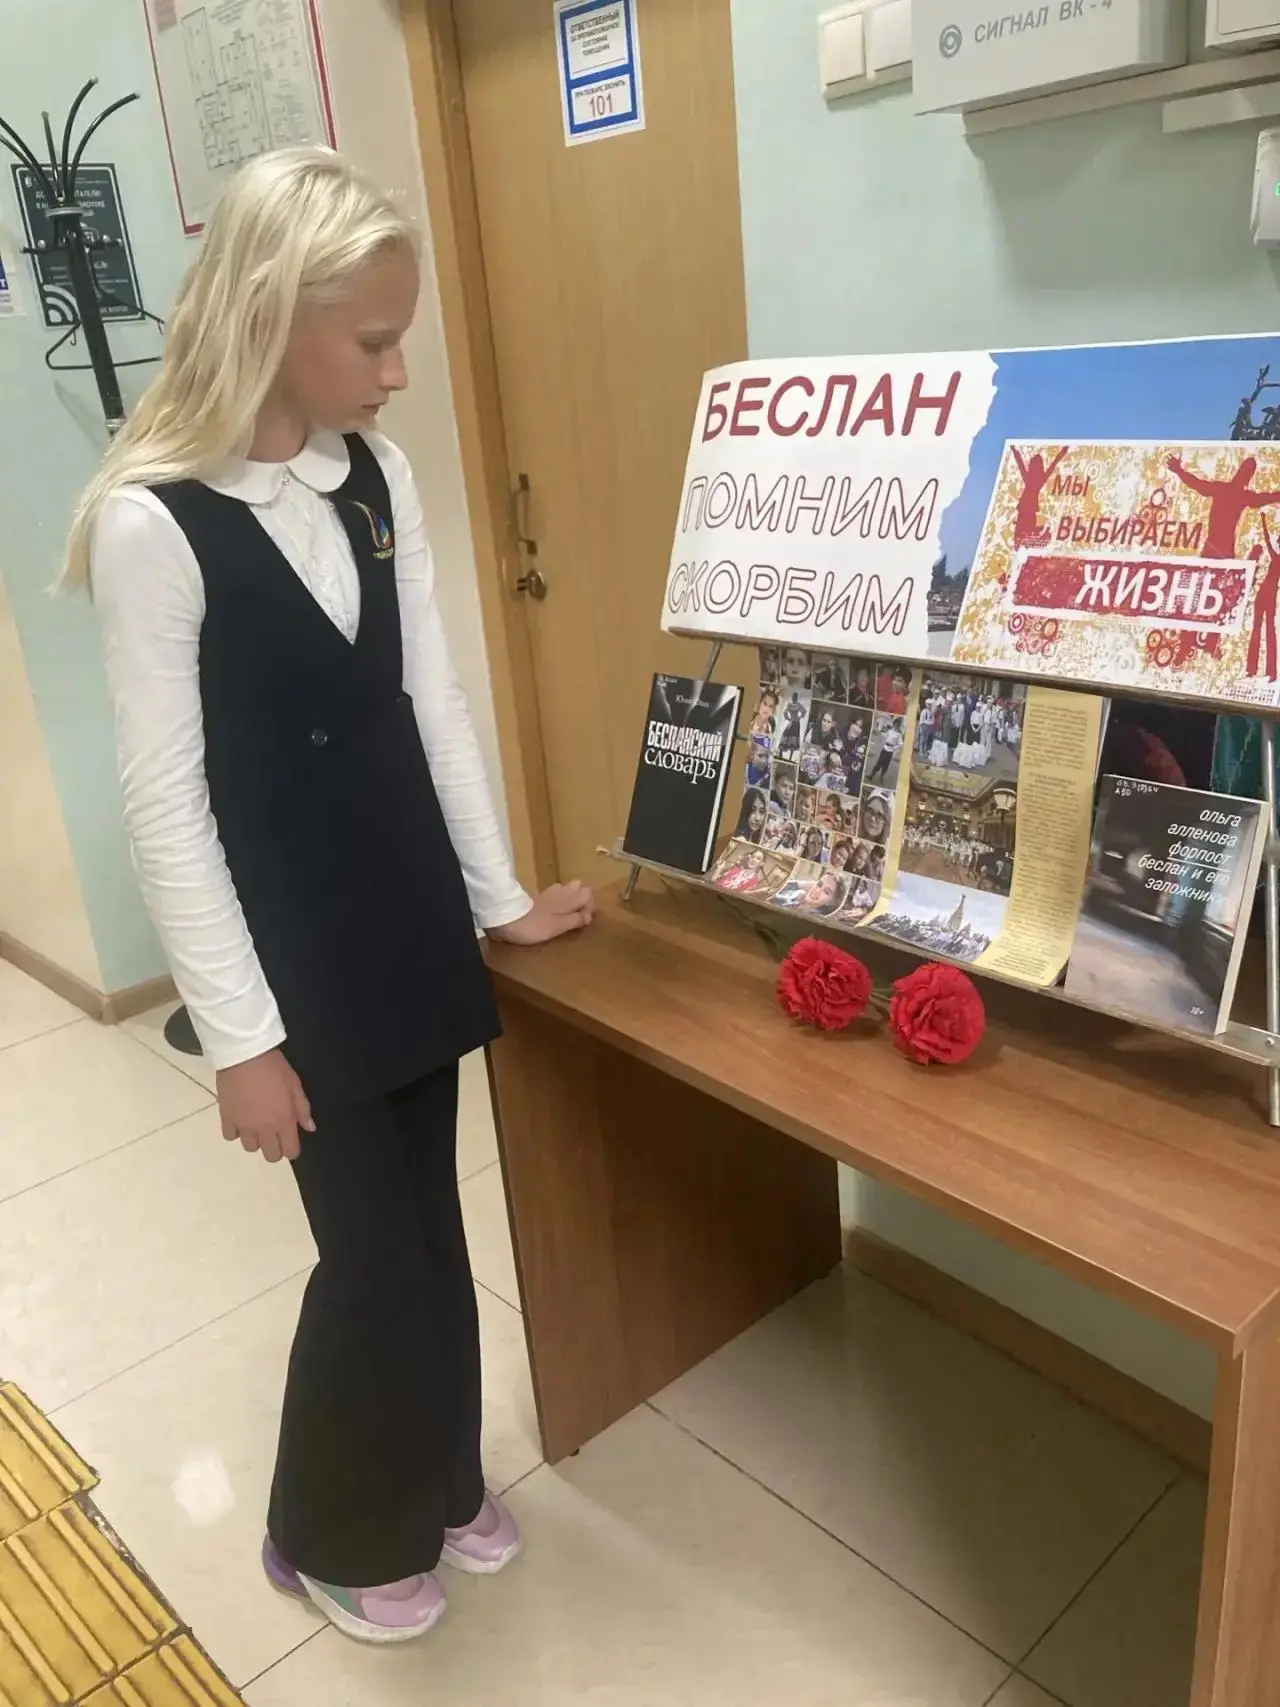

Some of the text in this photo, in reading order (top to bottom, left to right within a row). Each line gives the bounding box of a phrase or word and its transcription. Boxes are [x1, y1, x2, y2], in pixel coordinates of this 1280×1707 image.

[974, 6, 1049, 43] СИГНАЛ
[1059, 0, 1083, 21] ВК
[589, 92, 613, 117] 101
[702, 371, 962, 443] БЕСЛАН
[1051, 474, 1091, 497] МЫ
[682, 472, 939, 541] ПОМНИМ
[1056, 515, 1204, 550] ВЫБИРАЕМ
[668, 560, 914, 636] СКОРБИМ
[1074, 563, 1224, 617] ЖИЗНЬ
[647, 720, 723, 762] БЕСЛАНСКИЙ
[1167, 823, 1238, 847] алленова
[1199, 809, 1242, 827] ольга
[1138, 854, 1190, 877] беслан
[1190, 868, 1204, 880] и
[1168, 841, 1233, 865] форпост
